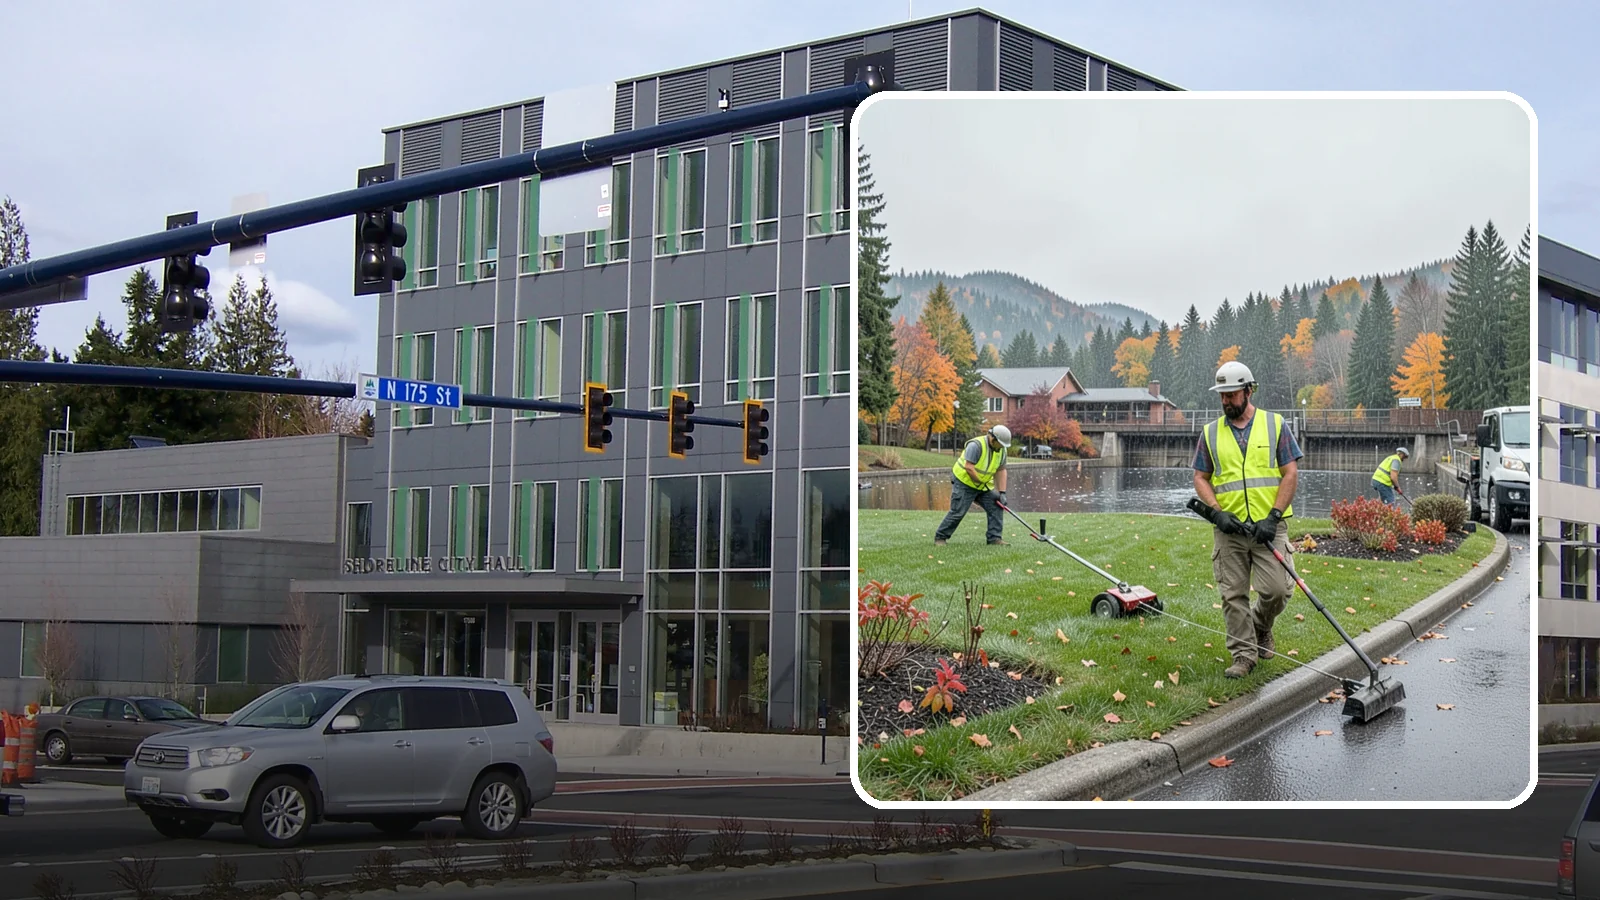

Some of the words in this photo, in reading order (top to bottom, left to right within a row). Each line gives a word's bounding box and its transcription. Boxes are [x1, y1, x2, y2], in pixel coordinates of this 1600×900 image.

[387, 380, 396, 400] N
[405, 382, 428, 403] 175
[436, 386, 451, 406] St
[343, 557, 431, 574] SHORELINE
[438, 556, 475, 572] CITY
[484, 555, 525, 572] HALL
